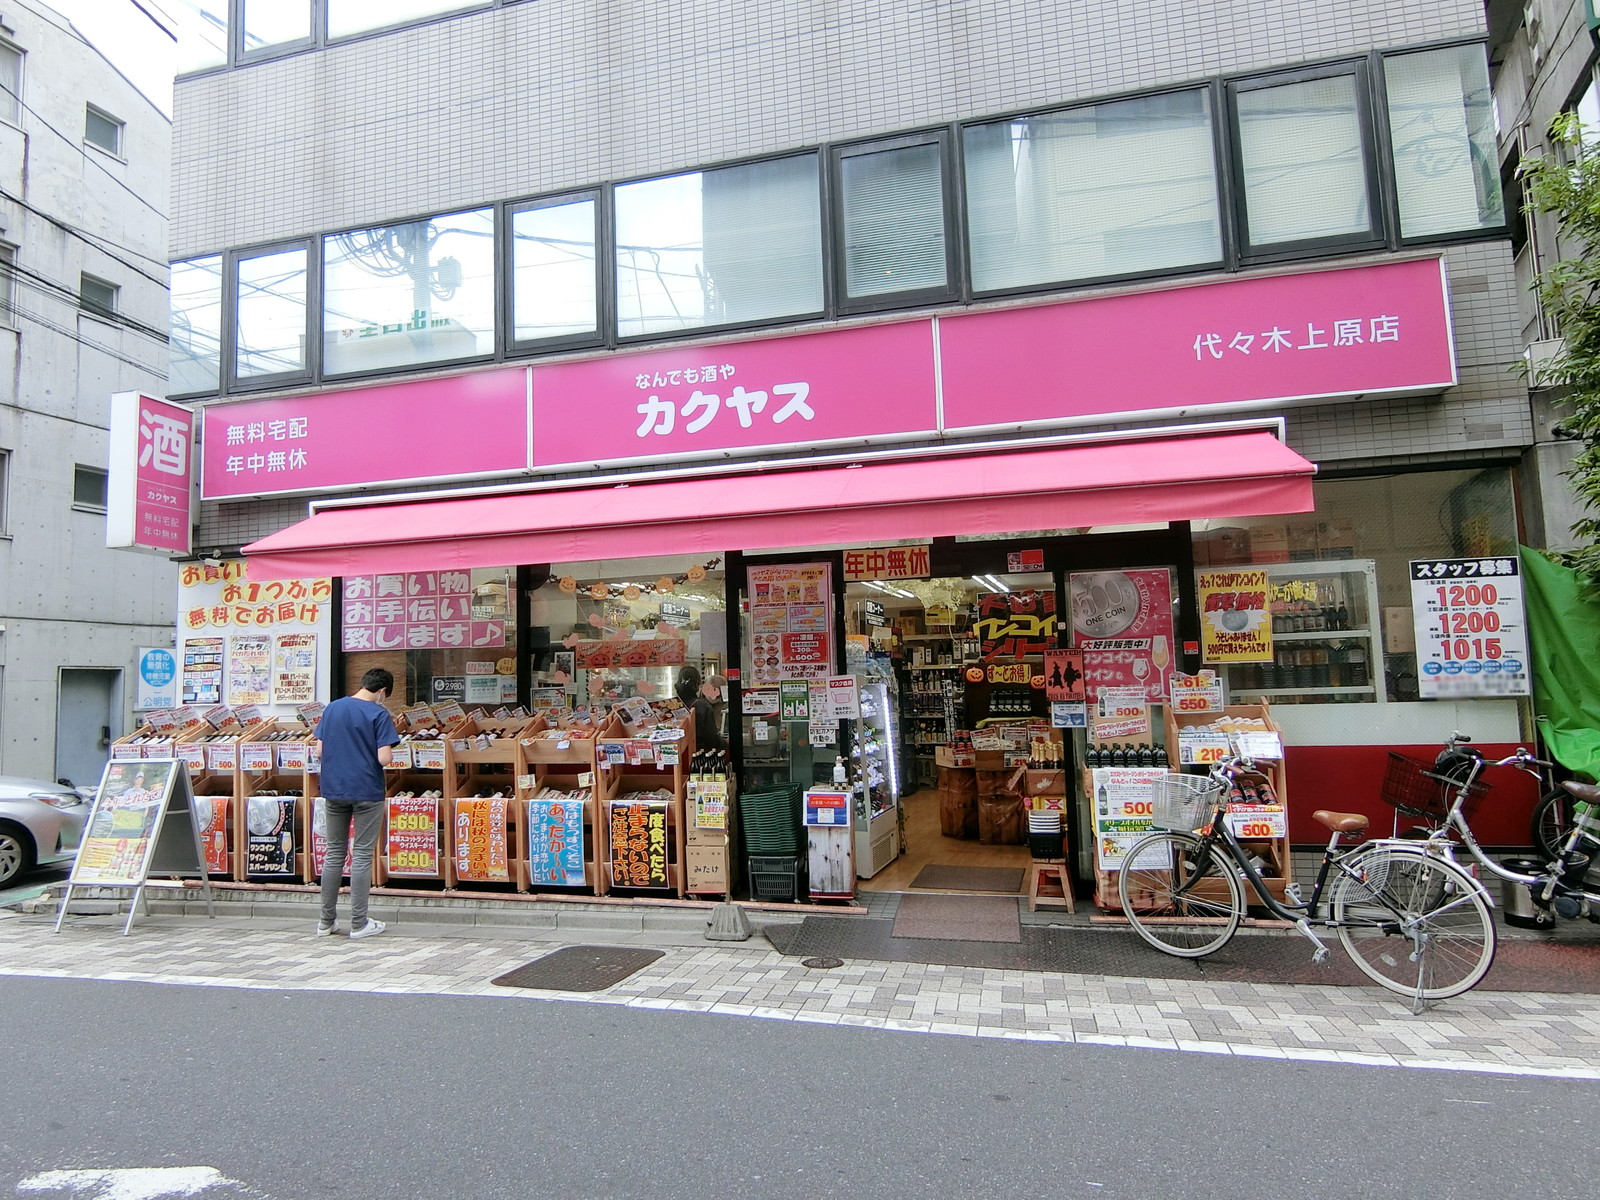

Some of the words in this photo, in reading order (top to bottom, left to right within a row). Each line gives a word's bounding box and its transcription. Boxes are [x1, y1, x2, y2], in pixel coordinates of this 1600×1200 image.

[1192, 314, 1400, 361] 代々木上原店
[634, 363, 736, 390] なんでも酒や
[636, 381, 815, 438] カクヤス
[139, 408, 189, 476] 酒
[226, 417, 308, 446] 無料宅配
[226, 448, 308, 476] 年中無休
[147, 490, 177, 505] カクヤス
[144, 512, 179, 528] 無料宅配
[144, 527, 178, 541] 年中無休
[845, 550, 929, 578] 年中無休
[1417, 559, 1513, 578] スタッフ募集
[224, 580, 331, 602] お1つから
[346, 572, 469, 598] お買い物
[1436, 584, 1497, 607] 1200
[188, 602, 320, 625] 無料でお届け
[345, 598, 469, 623] お手伝い
[1205, 592, 1266, 612] 衝撃価格
[1085, 614, 1103, 627] ONE
[1105, 606, 1127, 619] COIN
[1439, 611, 1500, 634] 1200
[1083, 640, 1148, 649] 大好評販売中!
[1441, 638, 1502, 661] 1015
[144, 697, 171, 706] 公明党
[531, 803, 542, 882] 季節になりました
[540, 804, 550, 881] おつまみが恋しい
[565, 803, 580, 869] 冬はもうすぐそこ
[628, 804, 650, 885] 止まらないので
[249, 863, 287, 871] スパークリング
[693, 865, 719, 873] みたけ
